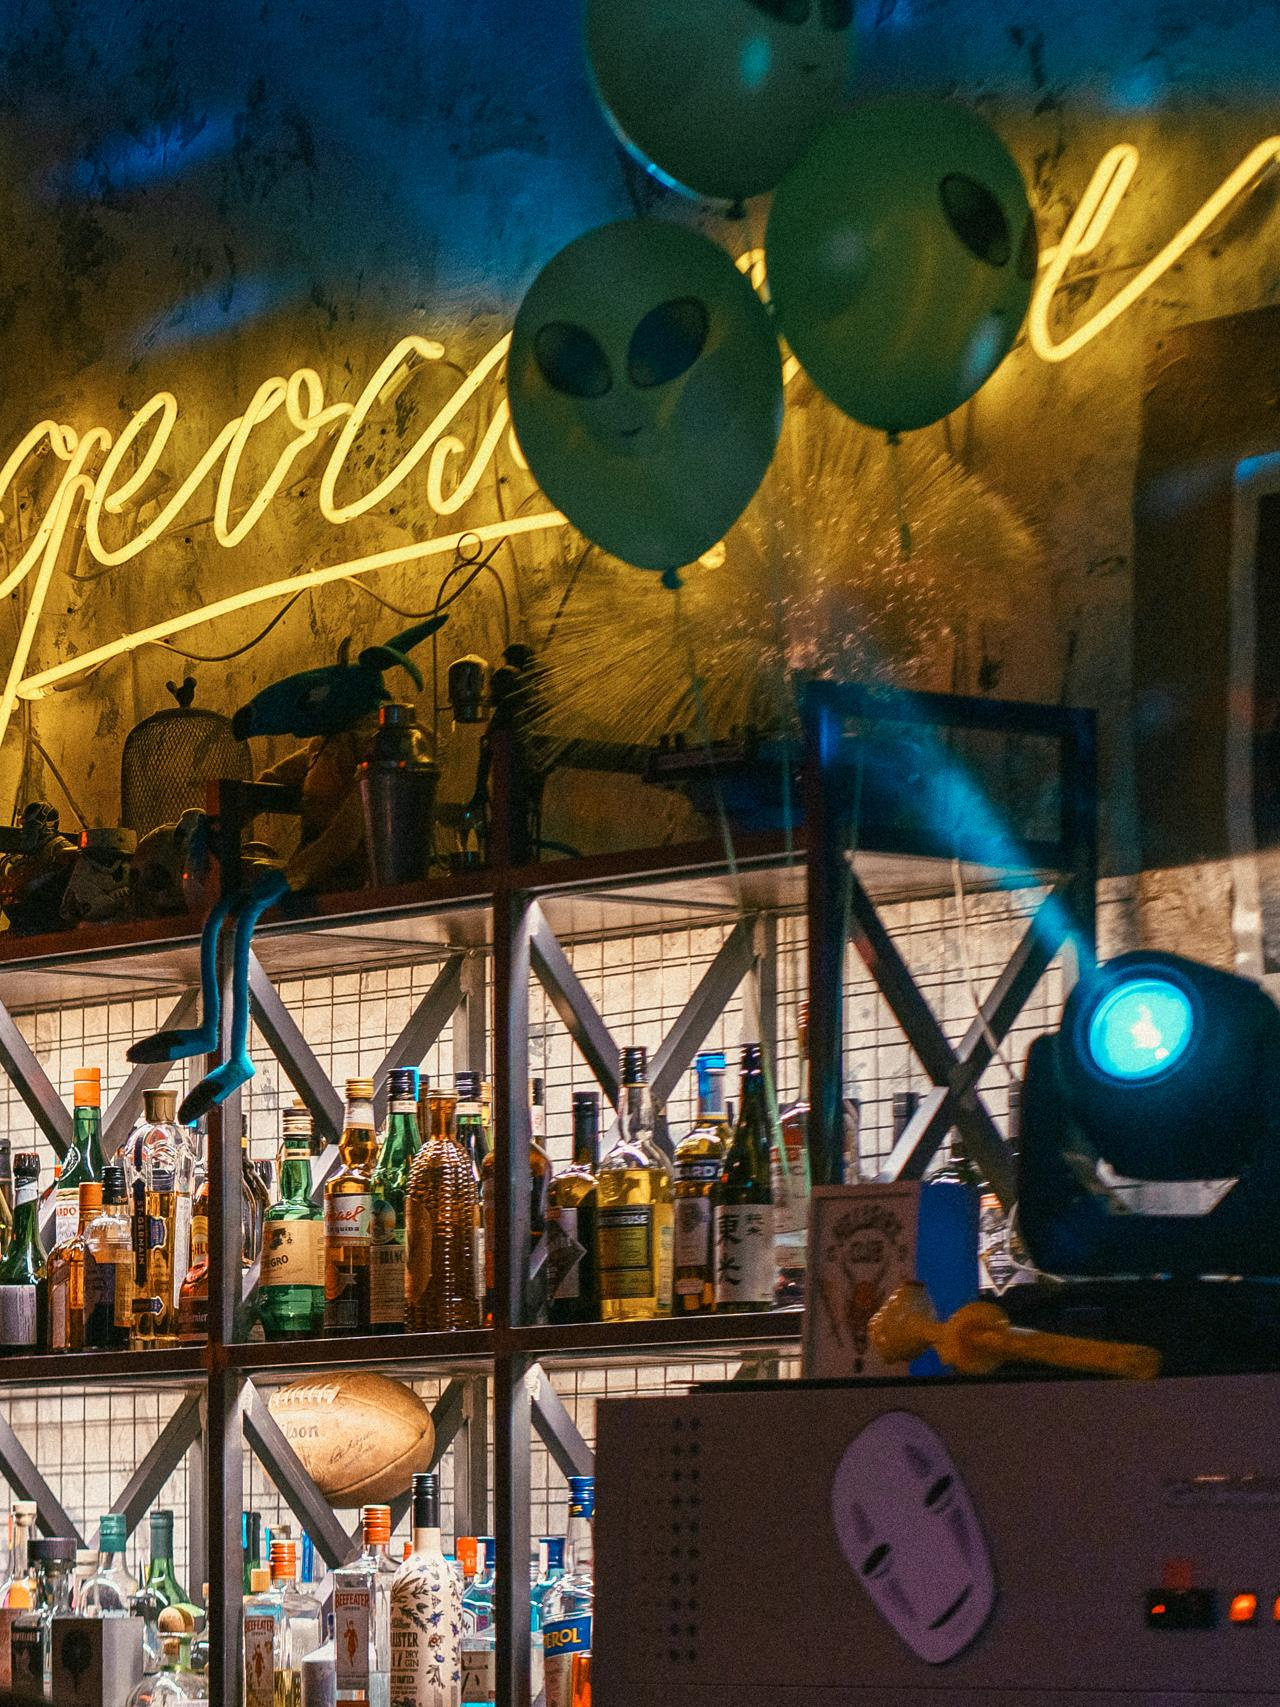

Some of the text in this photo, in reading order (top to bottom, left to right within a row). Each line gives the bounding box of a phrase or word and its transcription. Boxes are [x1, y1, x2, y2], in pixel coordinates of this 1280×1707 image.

[282, 1422, 319, 1440] ilson
[335, 1592, 370, 1607] BEEFEATER
[244, 1619, 274, 1633] BEEFEATER
